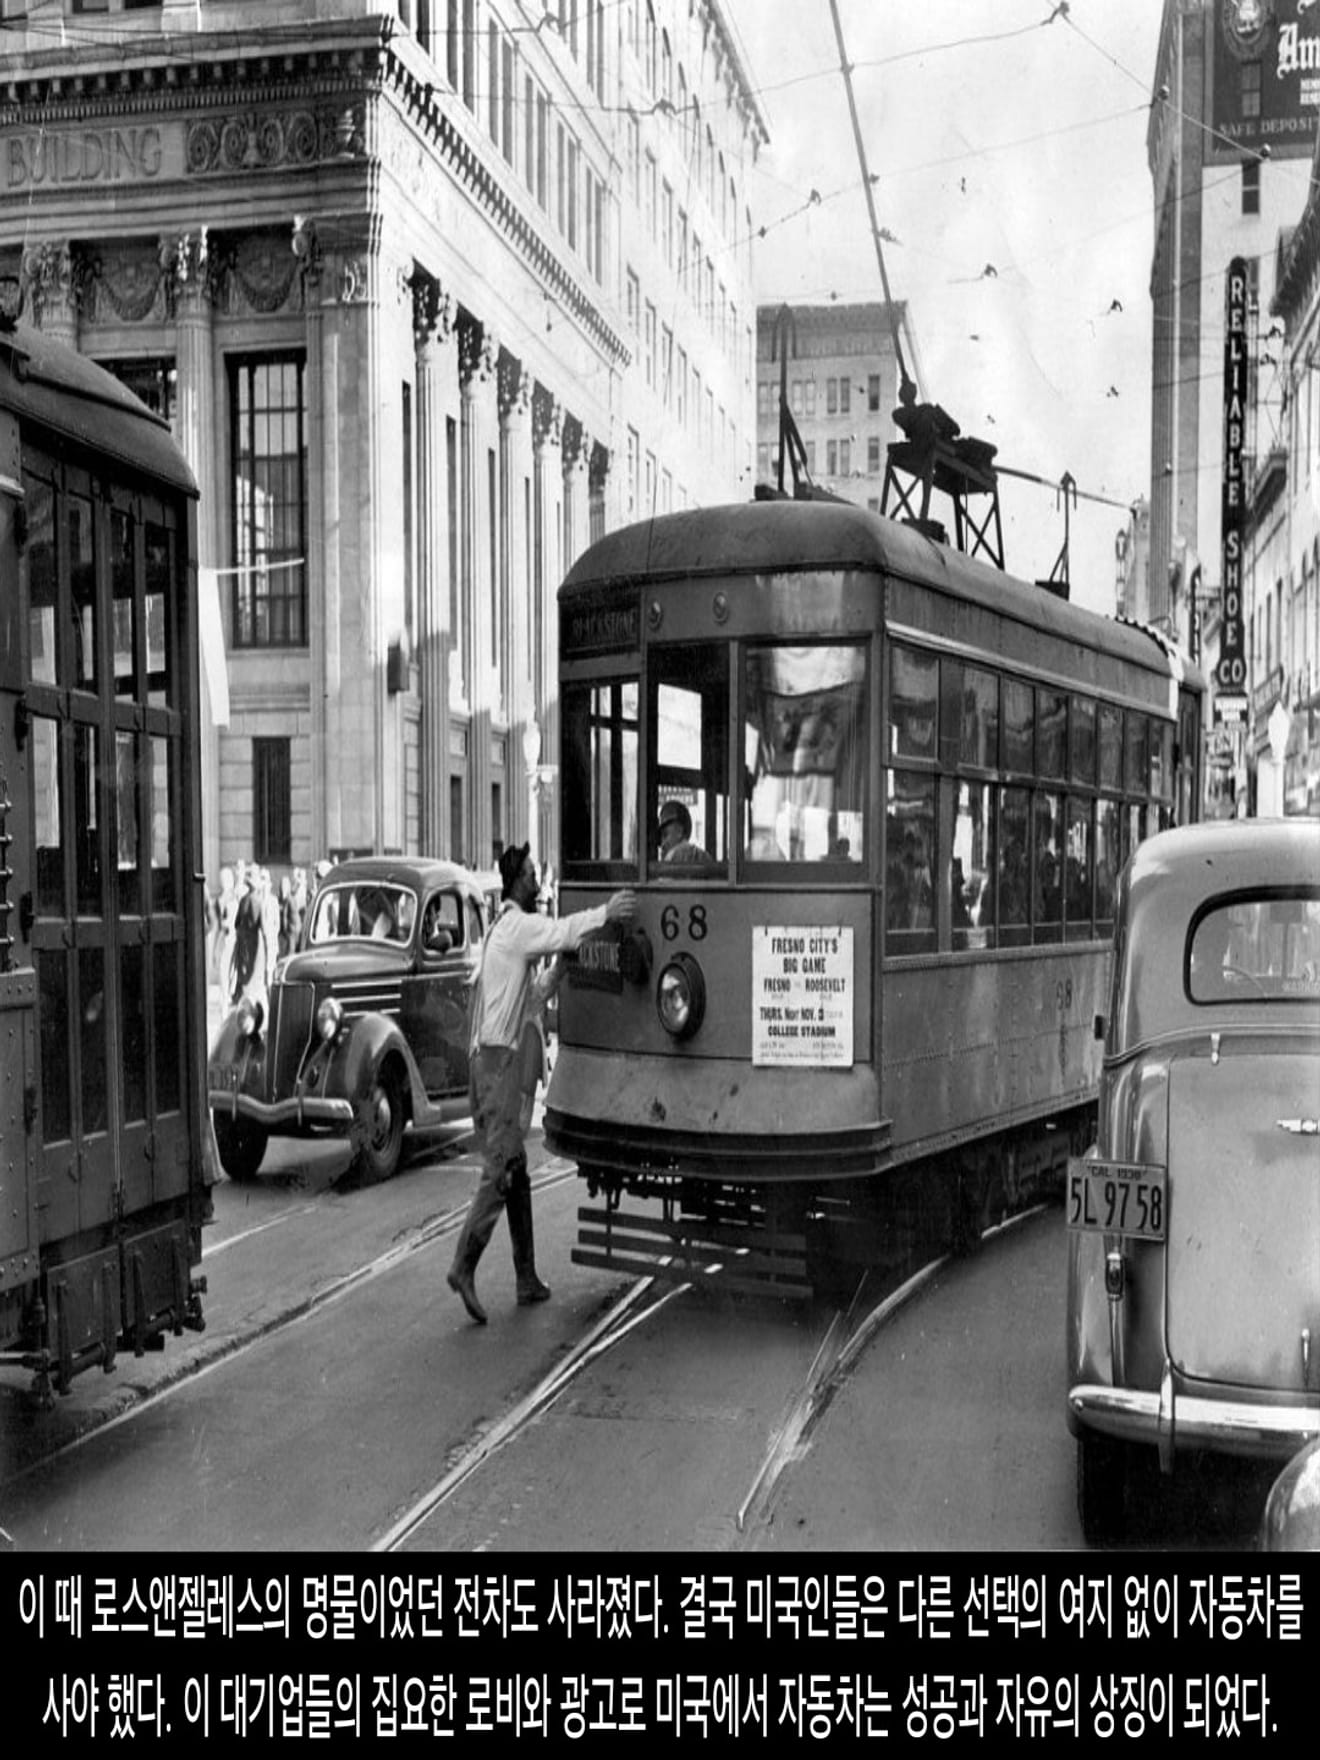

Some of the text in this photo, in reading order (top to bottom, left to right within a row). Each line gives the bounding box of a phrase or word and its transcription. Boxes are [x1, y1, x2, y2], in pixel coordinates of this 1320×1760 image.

[8, 127, 162, 188] BUILDING
[1228, 276, 1244, 507] RELIABLE
[1226, 531, 1240, 646] SHOE
[1219, 658, 1244, 684] CO
[661, 904, 708, 941] 68
[771, 937, 838, 955] FRESNO CITY'S
[783, 957, 826, 974] BIG GAME
[763, 978, 791, 992] FRESNO
[805, 978, 845, 992] ROOSEVELT
[768, 1025, 836, 1038] COLLEGE STADIUM
